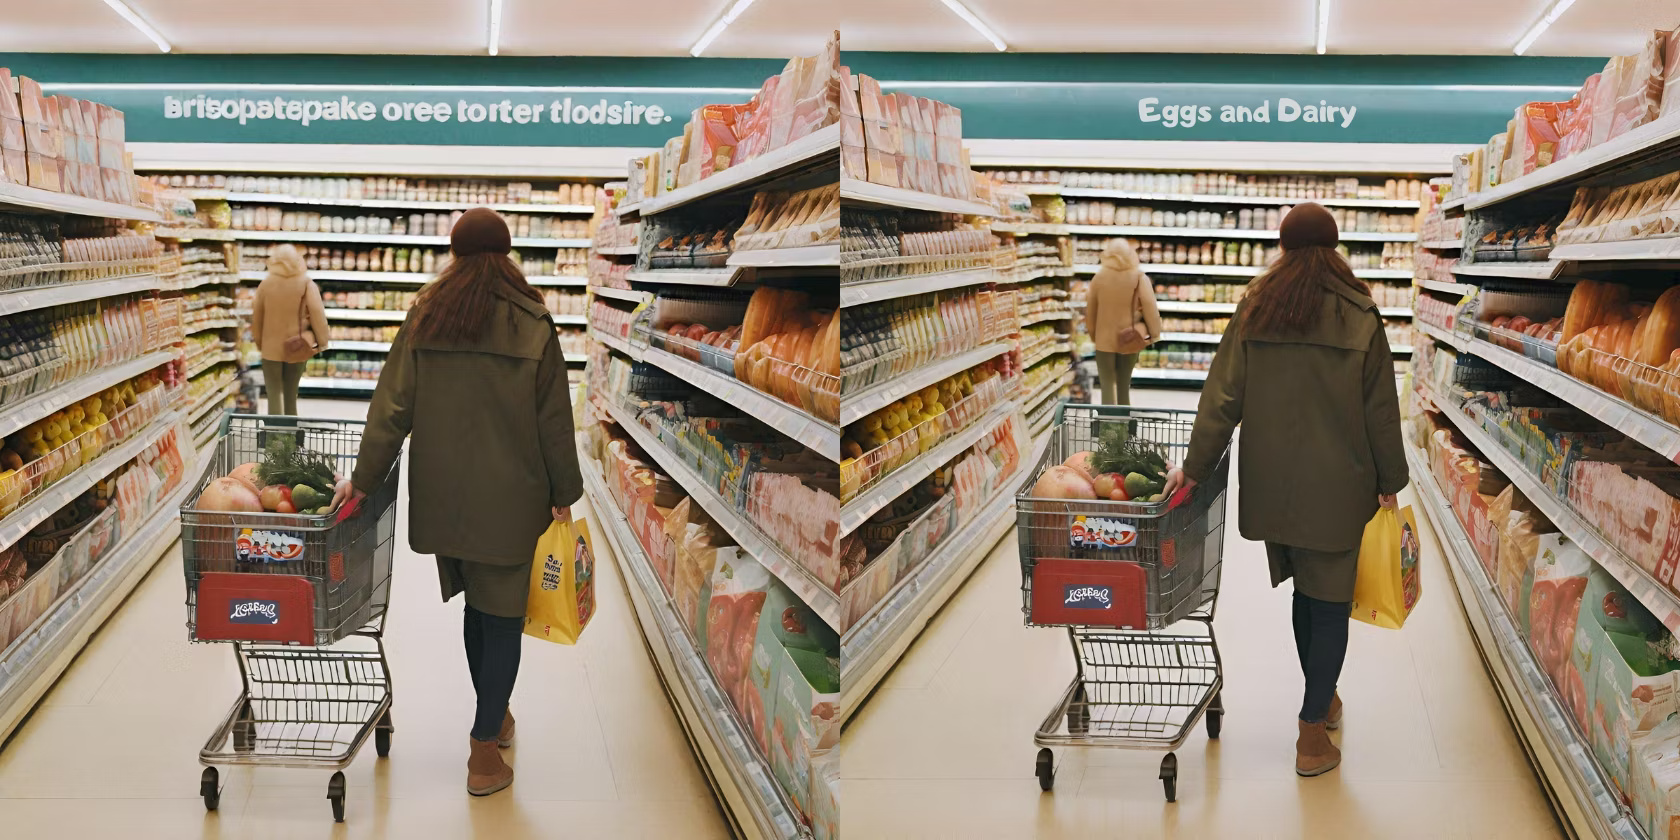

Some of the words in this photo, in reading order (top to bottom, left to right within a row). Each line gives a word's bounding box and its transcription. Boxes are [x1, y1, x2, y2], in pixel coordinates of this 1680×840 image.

[1138, 97, 1212, 128] Eggs
[1220, 99, 1271, 123] and
[1277, 97, 1357, 129] Dairy
